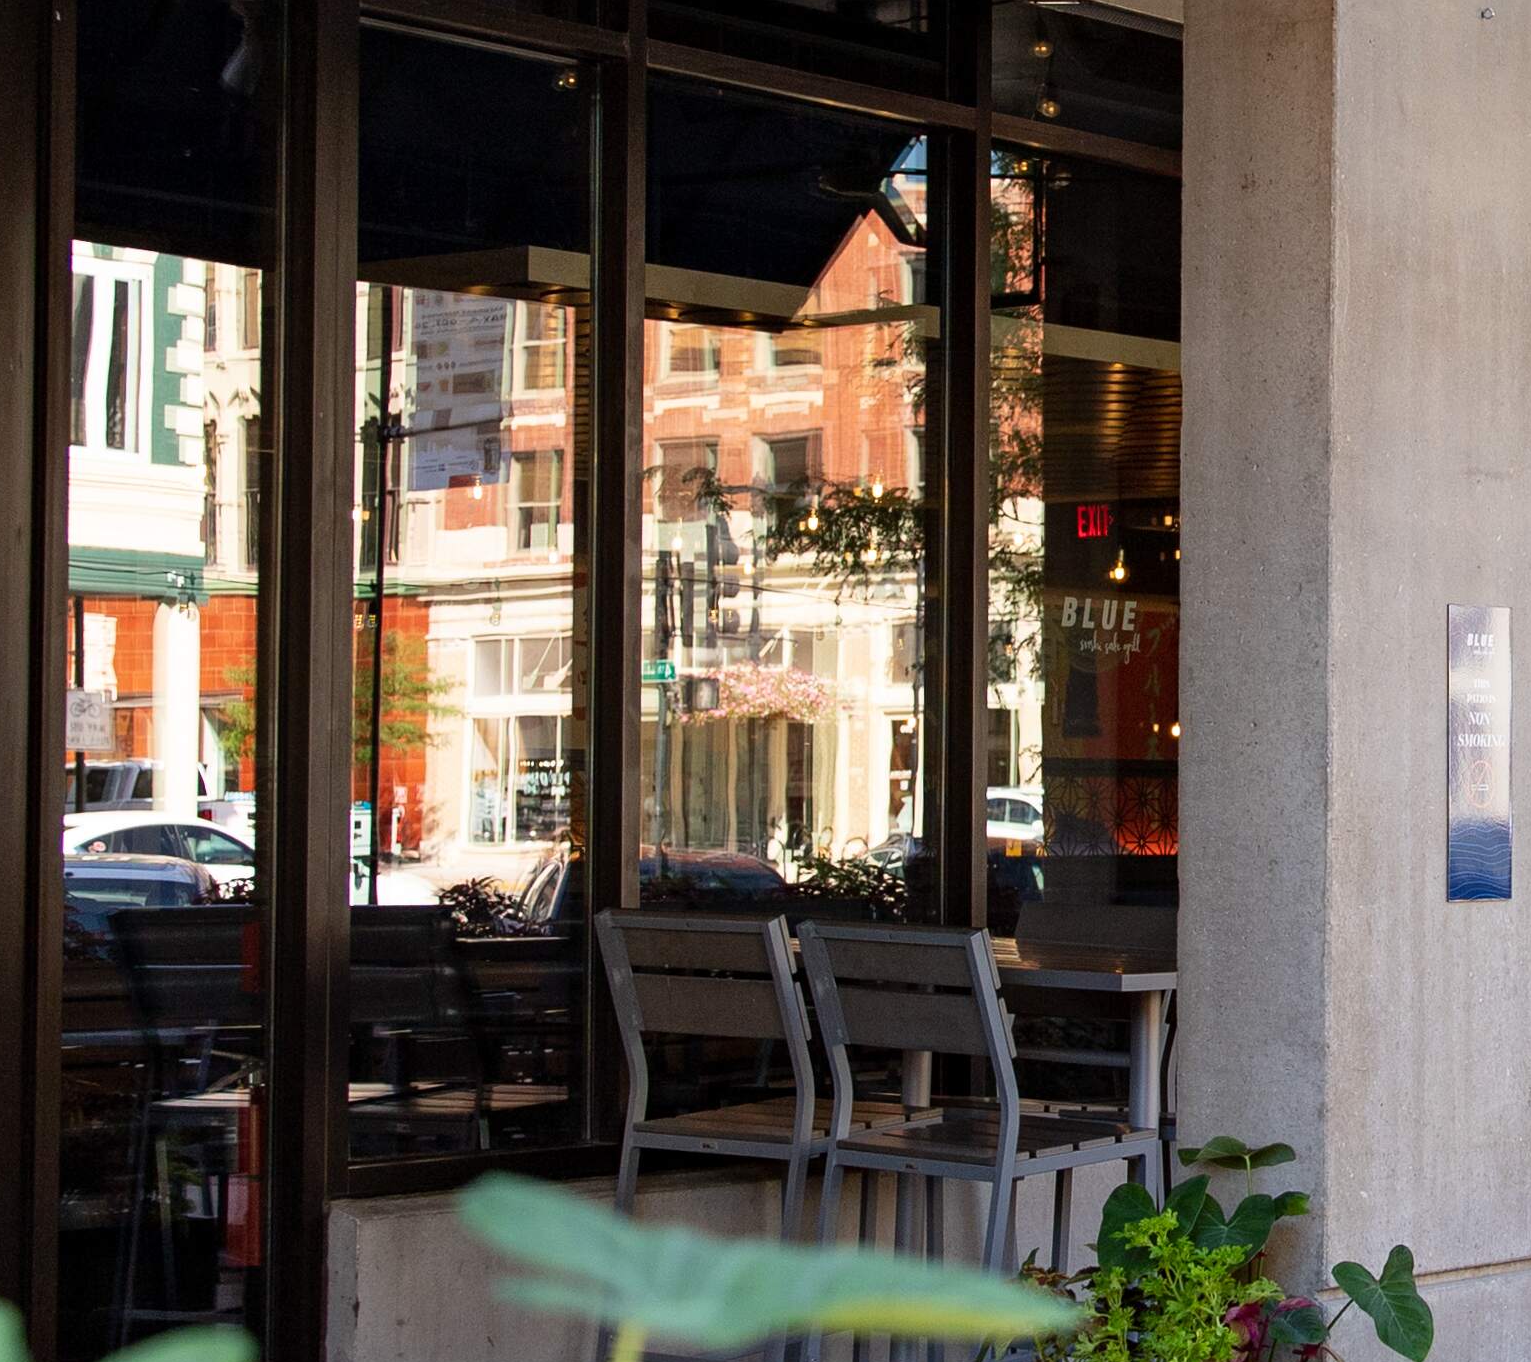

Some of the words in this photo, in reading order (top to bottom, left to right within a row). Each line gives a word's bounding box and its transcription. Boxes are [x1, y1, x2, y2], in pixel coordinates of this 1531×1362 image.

[1077, 503, 1108, 537] EXIT
[1061, 596, 1137, 631] BLUE
[1466, 633, 1494, 647] BLUE
[1468, 711, 1492, 726] NON
